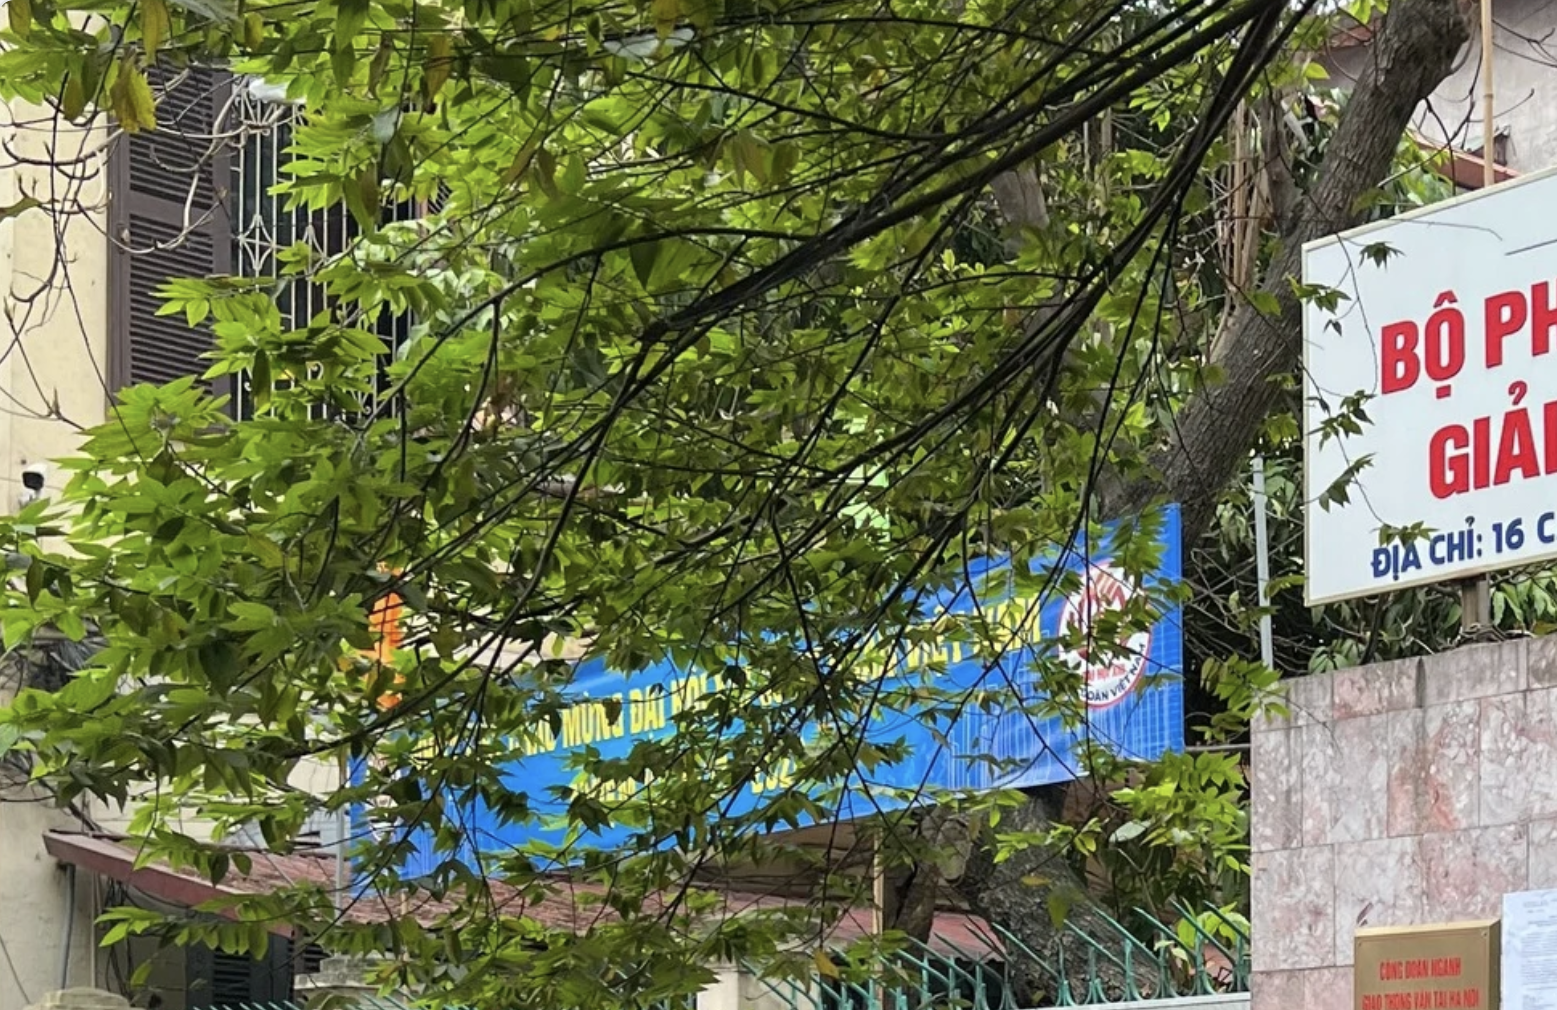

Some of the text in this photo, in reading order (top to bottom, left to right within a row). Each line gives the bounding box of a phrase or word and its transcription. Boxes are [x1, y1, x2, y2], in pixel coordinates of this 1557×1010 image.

[1381, 291, 1465, 398] BỘ
[1370, 542, 1422, 581] ĐỊA
[1492, 517, 1525, 553] 16
